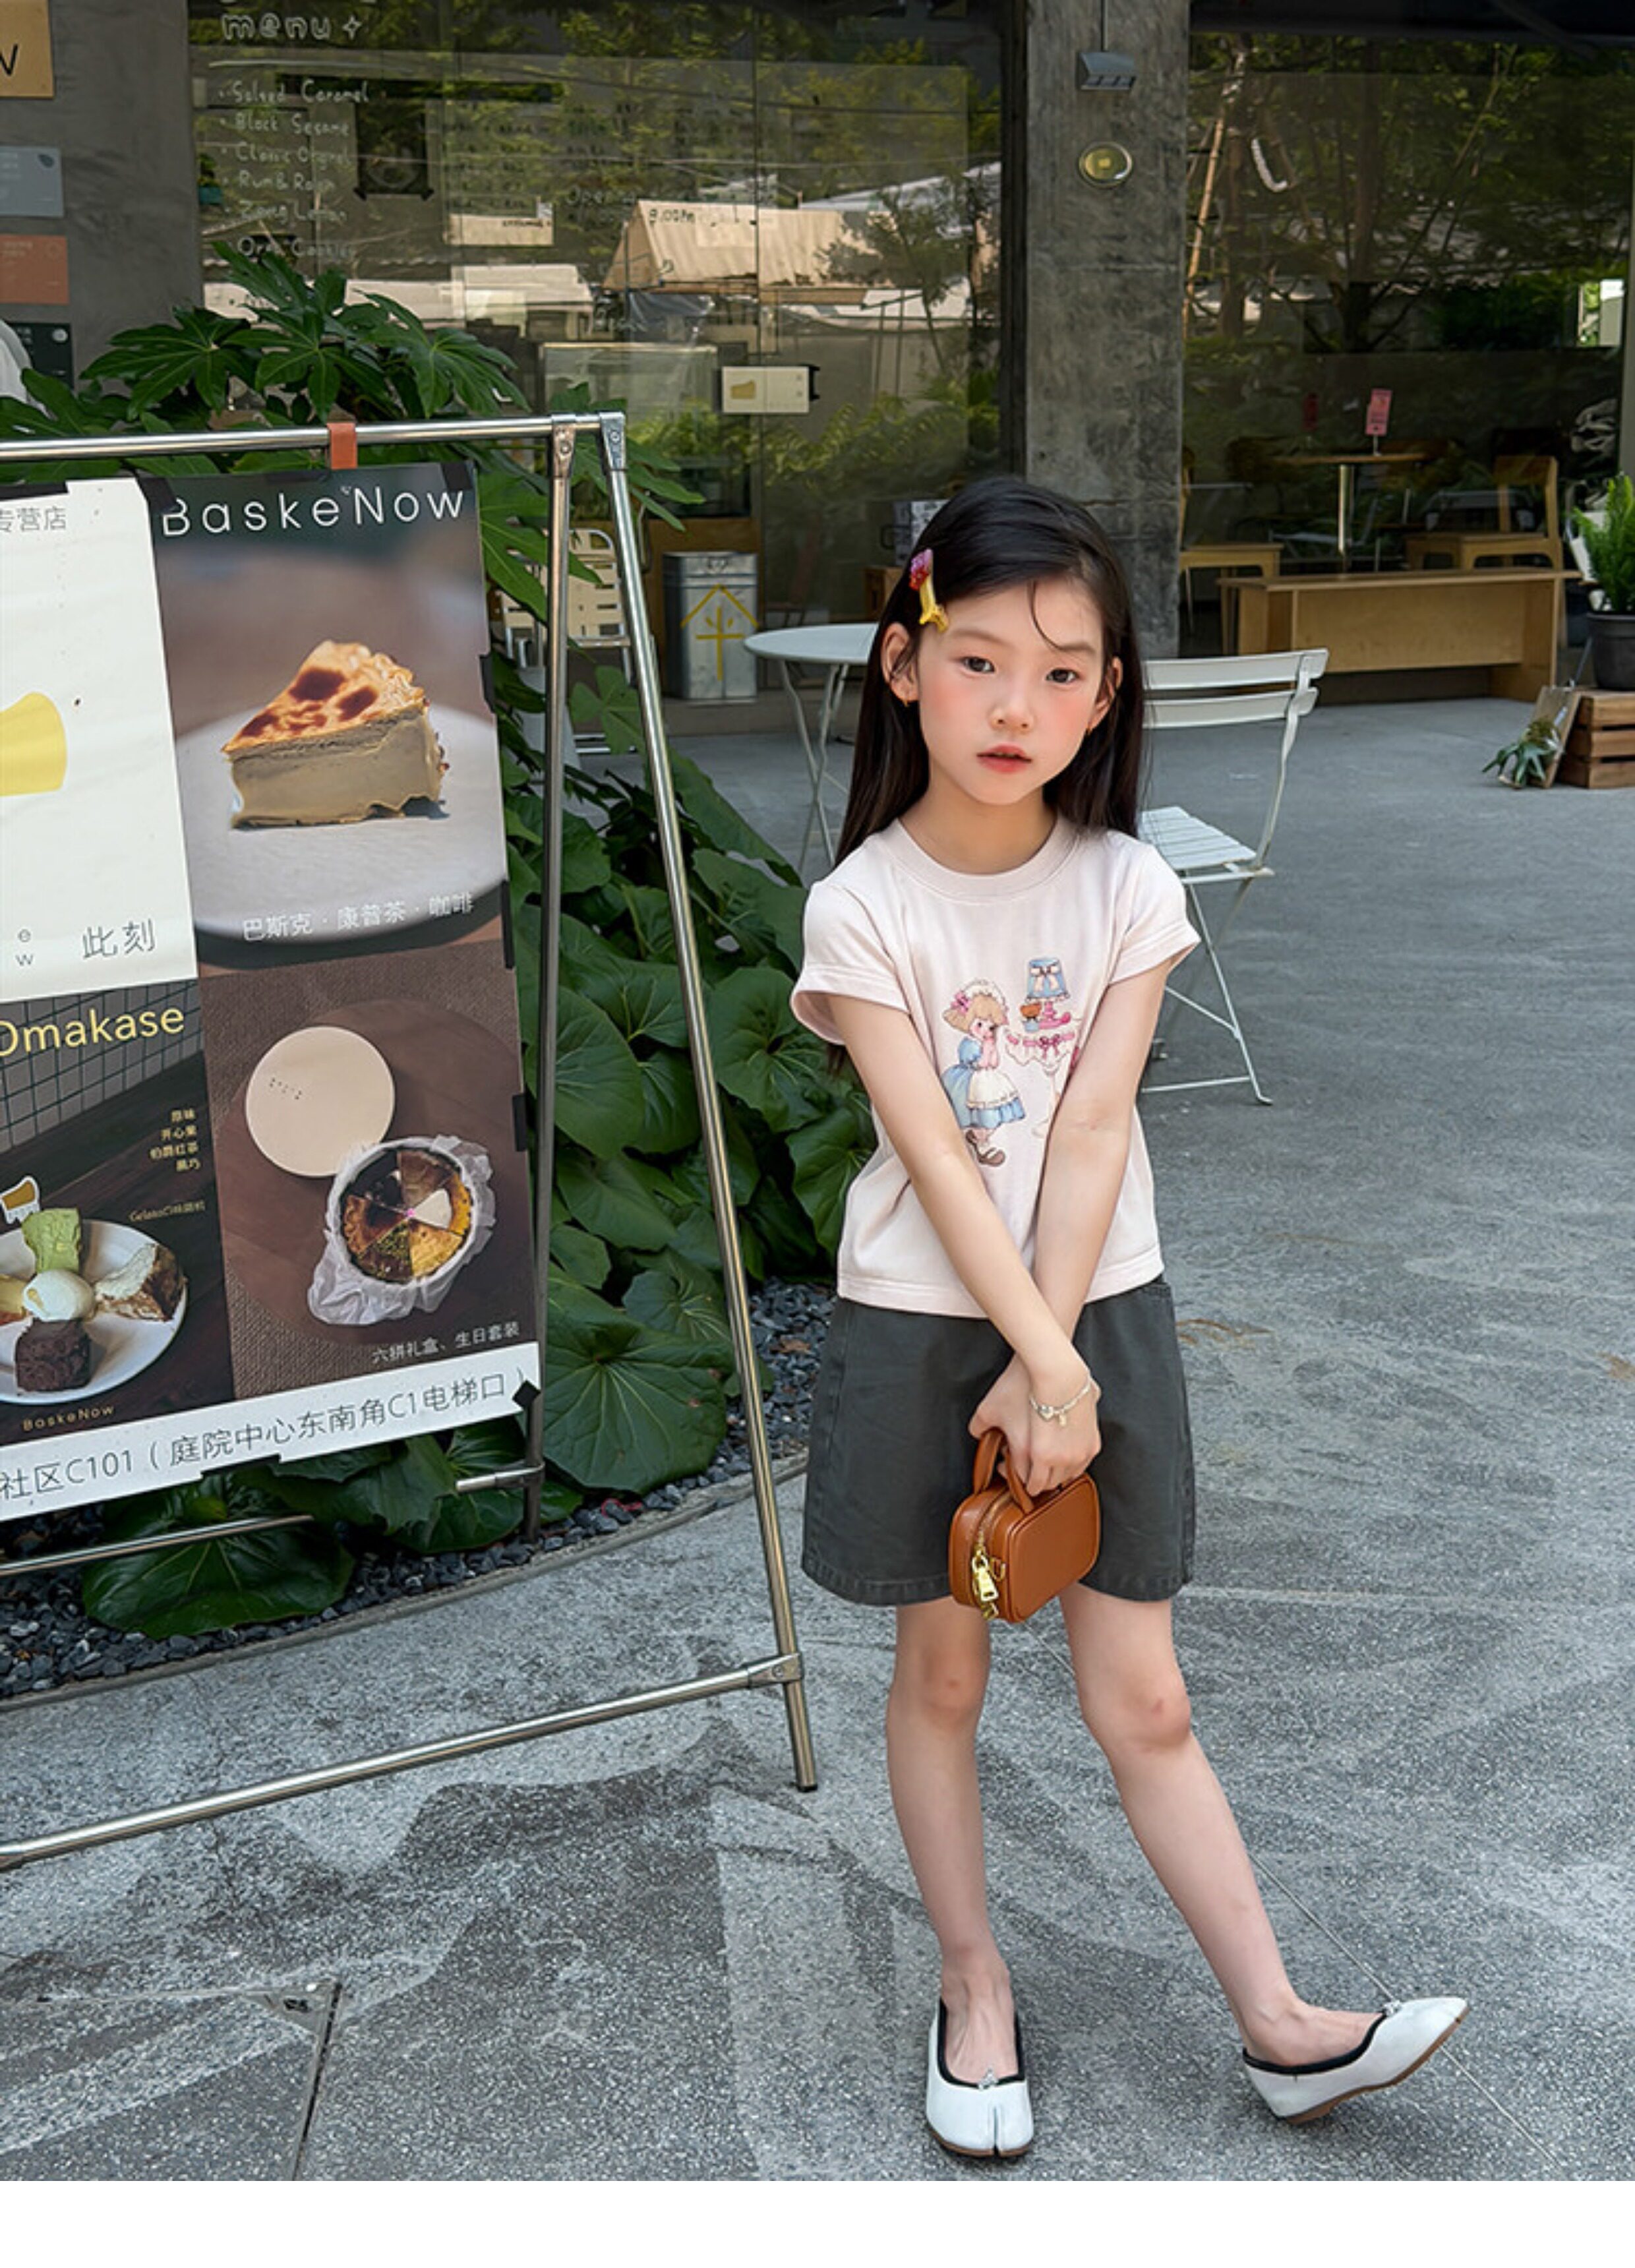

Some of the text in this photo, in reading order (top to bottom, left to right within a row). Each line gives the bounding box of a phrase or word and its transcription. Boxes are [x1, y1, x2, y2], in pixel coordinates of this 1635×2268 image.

[222, 13, 330, 40] menu
[162, 486, 463, 537] BaskeNow
[82, 918, 156, 959] 此刻
